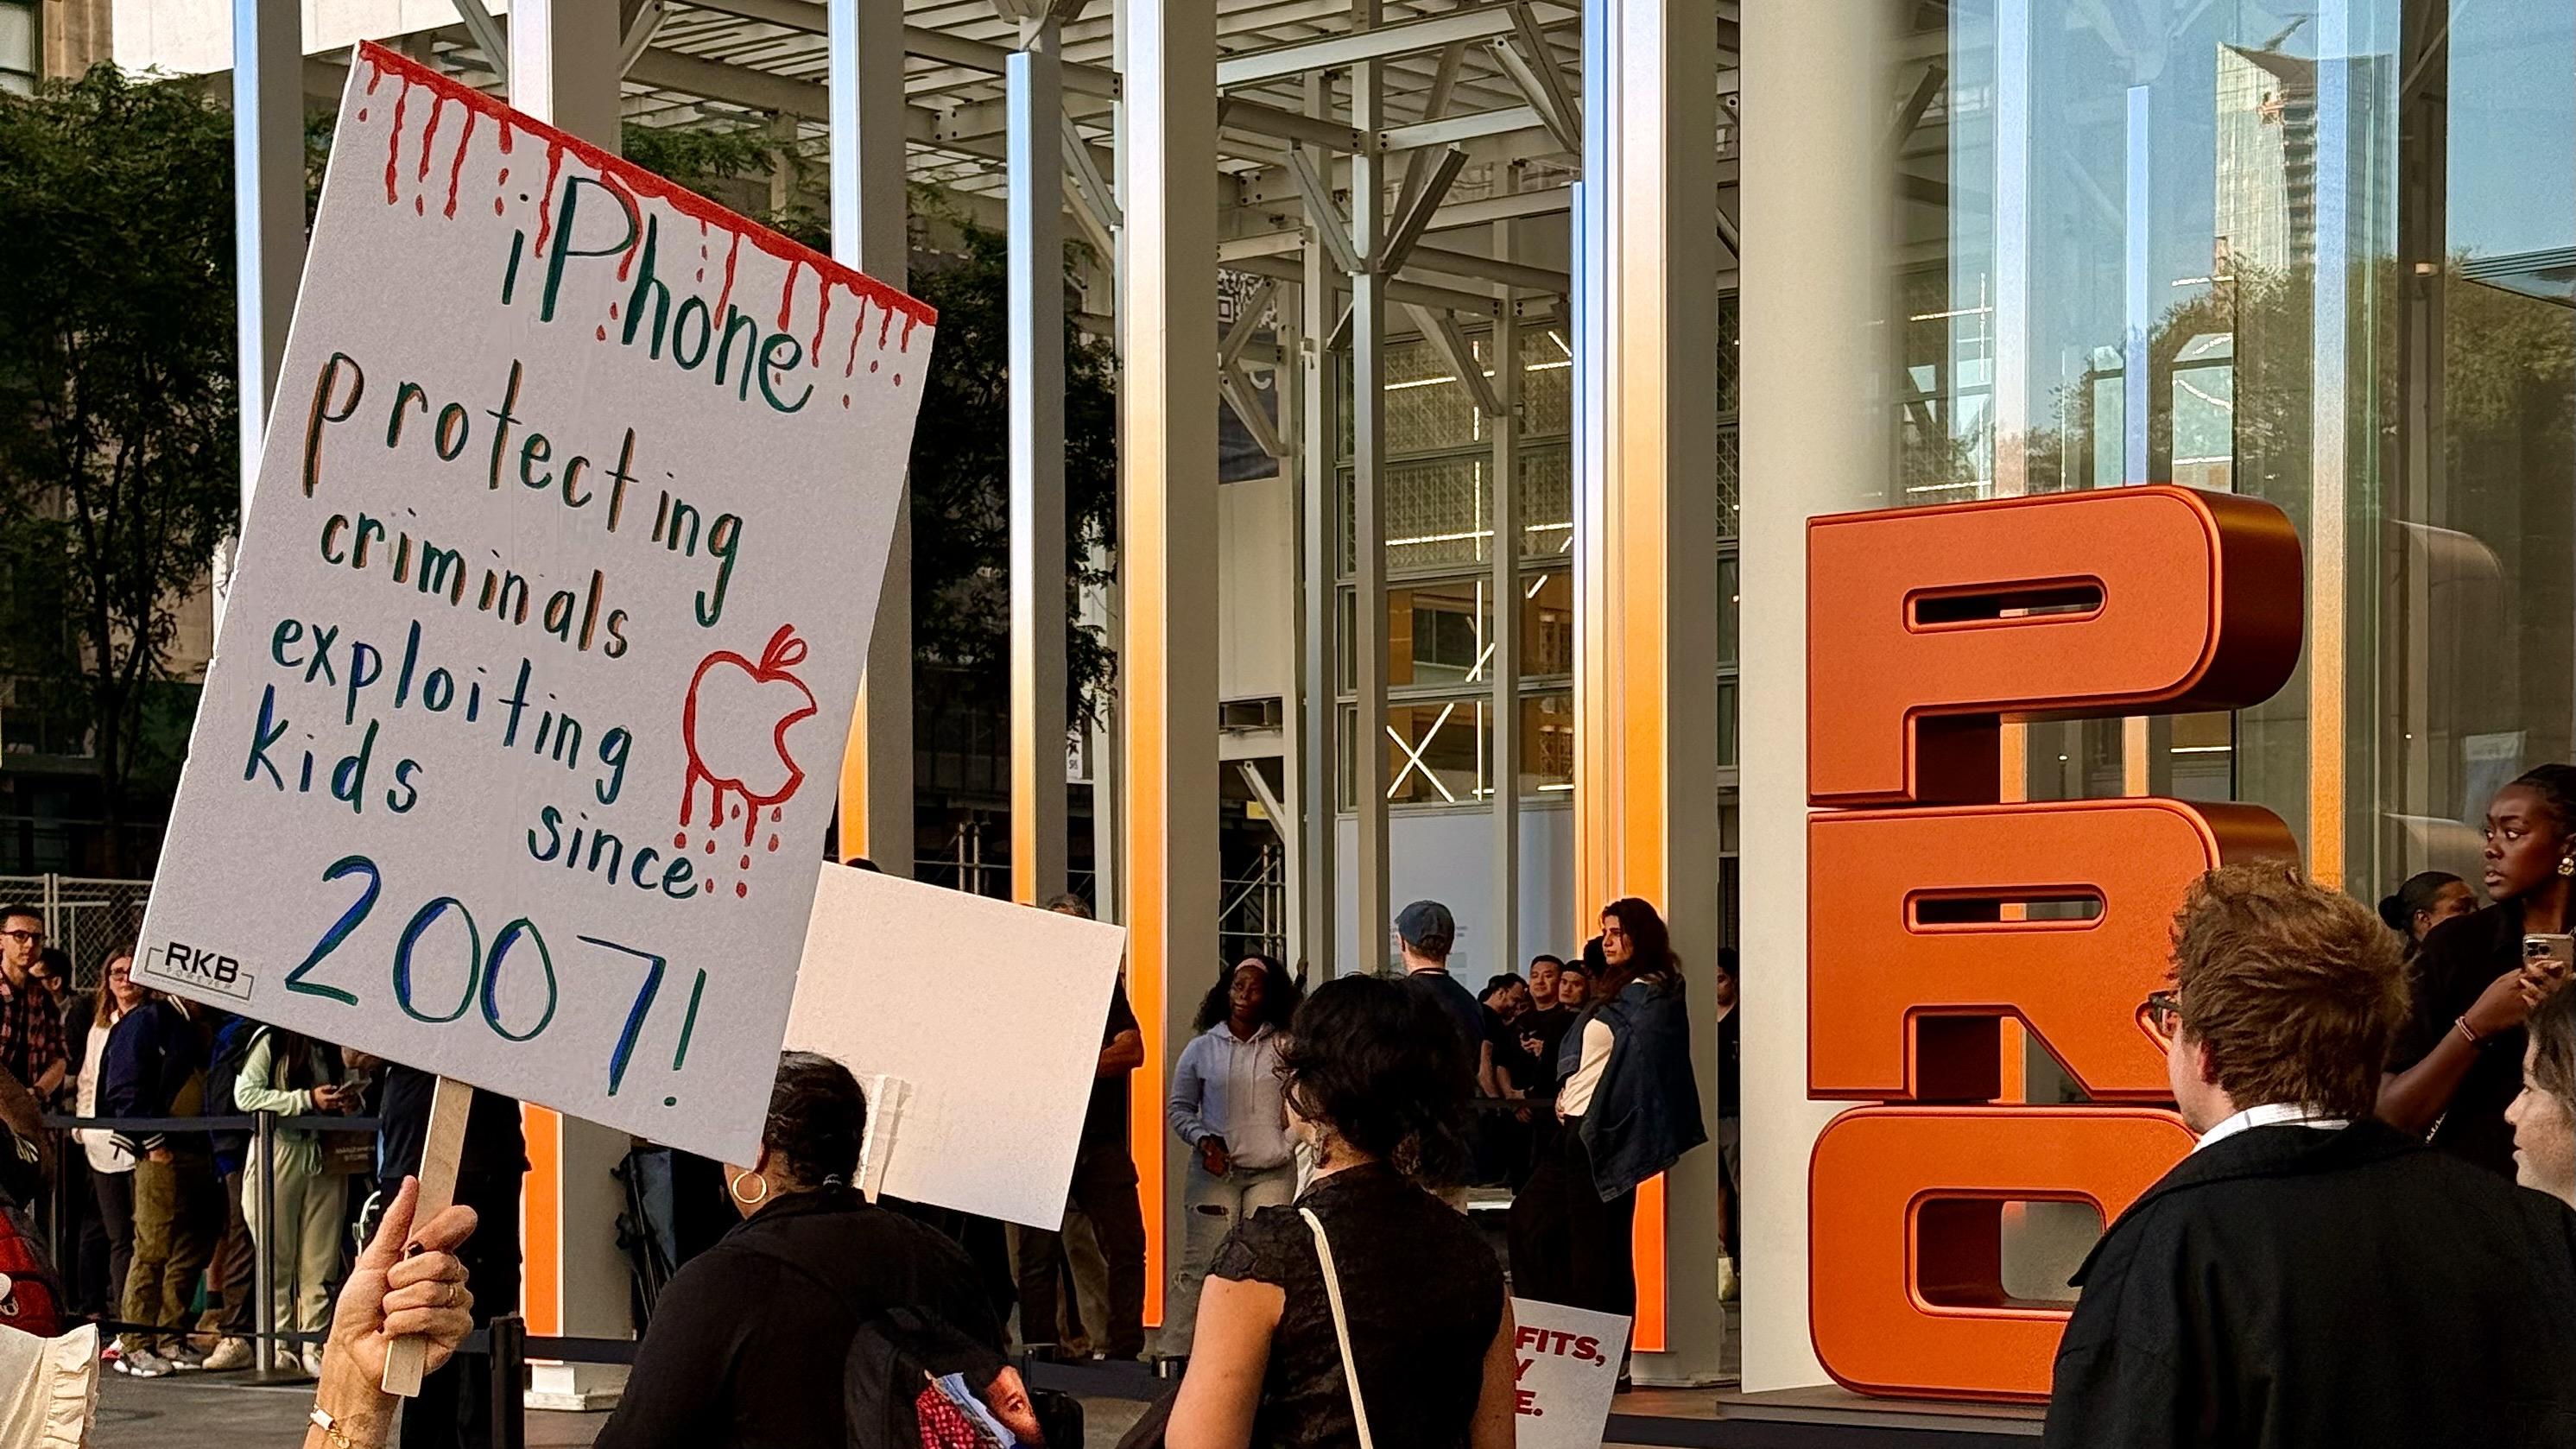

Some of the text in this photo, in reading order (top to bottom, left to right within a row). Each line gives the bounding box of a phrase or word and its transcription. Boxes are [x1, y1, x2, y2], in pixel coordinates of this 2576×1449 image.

[502, 175, 813, 413] iPhone
[302, 351, 744, 629] protecting
[320, 508, 629, 659] criminals
[244, 684, 698, 899] kids since
[271, 617, 633, 805] exploiting
[165, 941, 239, 984] RKB
[285, 855, 707, 1106] 2007!
[1807, 484, 2303, 1402] PRO
[1515, 1325, 1606, 1368] FITS,
